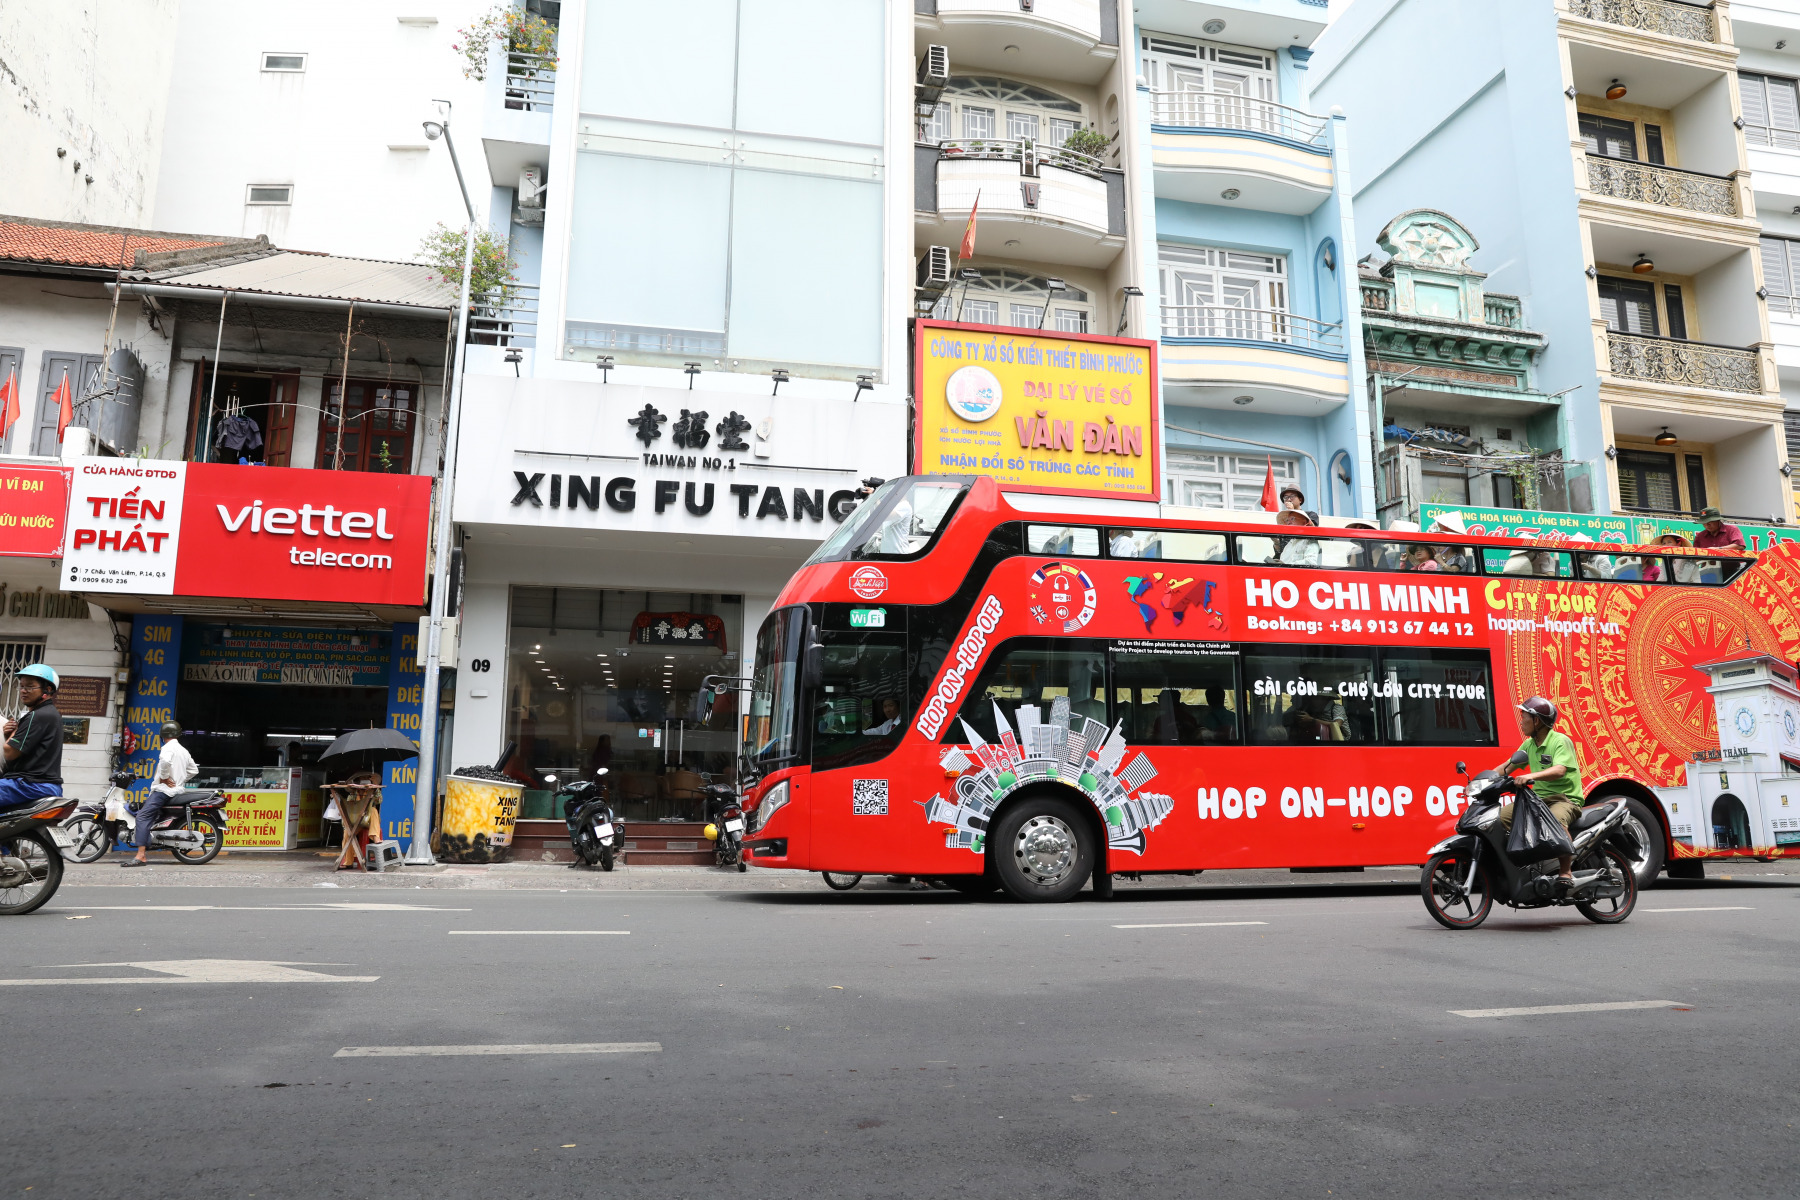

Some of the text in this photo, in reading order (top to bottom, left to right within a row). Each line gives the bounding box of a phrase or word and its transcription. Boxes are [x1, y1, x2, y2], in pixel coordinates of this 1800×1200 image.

[931, 336, 1144, 375] CÔNG TY XỔ SỐ KIẾN THIẾT BÌNH PHƯỚC
[1024, 380, 1133, 406] ĐẠI LÝ VÉ SỐ
[628, 403, 751, 451] 幸福堂
[1014, 410, 1142, 457] VĂN ĐÀN
[83, 464, 177, 479] CỬA HÀNG ĐTDĐ
[643, 453, 736, 471] TAIWAN NO.1
[940, 452, 1134, 479] NHẬN ĐỔI SỐ TRÚNG CÁC TỈNH
[6, 477, 20, 490] VĨ
[22, 480, 44, 493] ĐẠI
[87, 485, 165, 520] TIẾN
[510, 471, 858, 522] XING FU TANG
[20, 515, 55, 529] NƯỚC
[216, 499, 394, 541] viettel
[1480, 513, 1500, 522] HOA
[1503, 513, 1524, 524] KHÔ
[1532, 514, 1558, 527] LỒNG
[1559, 516, 1579, 527] ĐÈN
[1587, 519, 1602, 529] ĐỒ
[1603, 521, 1626, 530] CƯỚI
[73, 523, 170, 553] PHÁT
[289, 546, 392, 570] telecom
[9, 586, 40, 618] CHÍ
[42, 592, 89, 619] MINH
[1245, 578, 1470, 614] HO CHI MINH
[1545, 592, 1598, 614] TOUR
[143, 625, 172, 643] SIM
[1246, 614, 1474, 637] Booking: +84 913 67 44 12
[1488, 613, 1620, 638] hopon-hopoff.vn
[225, 640, 247, 648] THAY
[282, 630, 303, 640] SỬA
[306, 631, 333, 641] ĐIỆN
[144, 649, 165, 665] 4G
[471, 658, 491, 673] 09
[186, 664, 208, 680] BÁN
[210, 665, 233, 681] ÁO
[262, 671, 280, 680] DÁN
[282, 668, 303, 683] SIM
[917, 696, 946, 740] HOP
[938, 669, 964, 702] ON
[956, 626, 987, 669] HOP
[977, 594, 1004, 633] OFF
[138, 677, 168, 696] CÁC
[1253, 675, 1486, 701] SÀI GÒN CHỢ LỚN CITY TOUR
[127, 707, 172, 727] MẠNG
[237, 794, 257, 804] 4G
[497, 796, 518, 807] XING
[1197, 786, 1267, 820] HOP
[226, 807, 250, 822] ĐIỆN
[253, 809, 282, 822] THOẠI
[494, 816, 516, 826] TANG
[502, 807, 513, 816] FU
